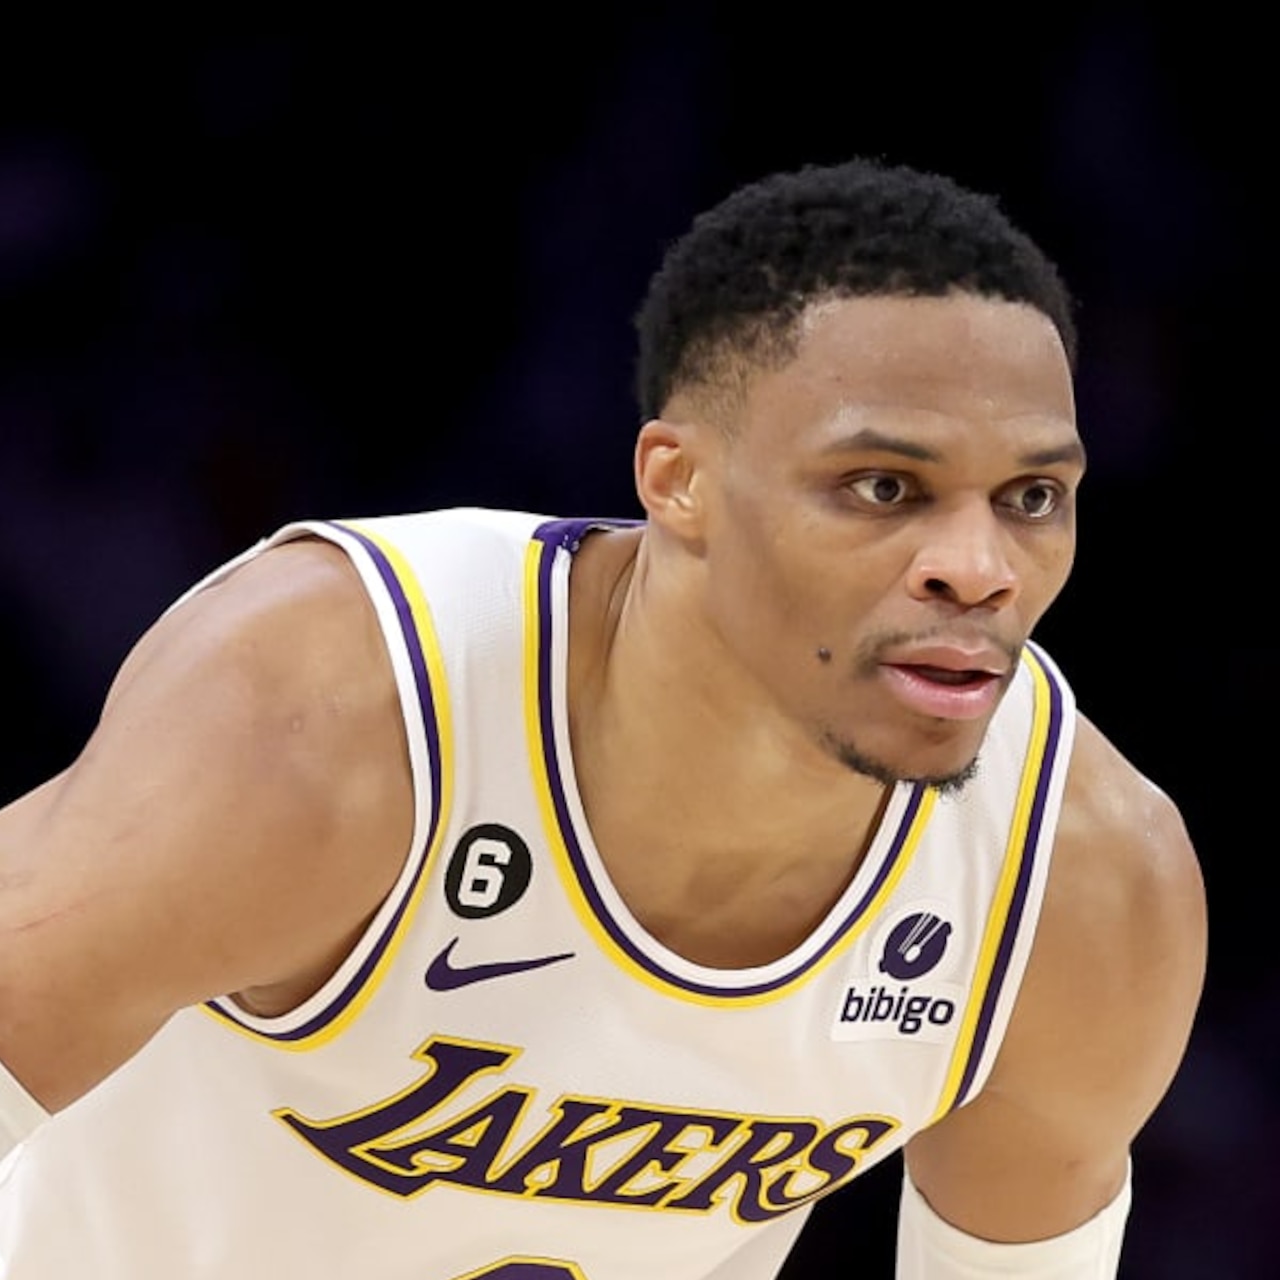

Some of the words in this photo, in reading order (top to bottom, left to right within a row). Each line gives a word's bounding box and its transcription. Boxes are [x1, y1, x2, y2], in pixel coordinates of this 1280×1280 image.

[459, 838, 512, 906] 6
[840, 986, 954, 1034] bibigo
[273, 1035, 901, 1226] LAKERS
